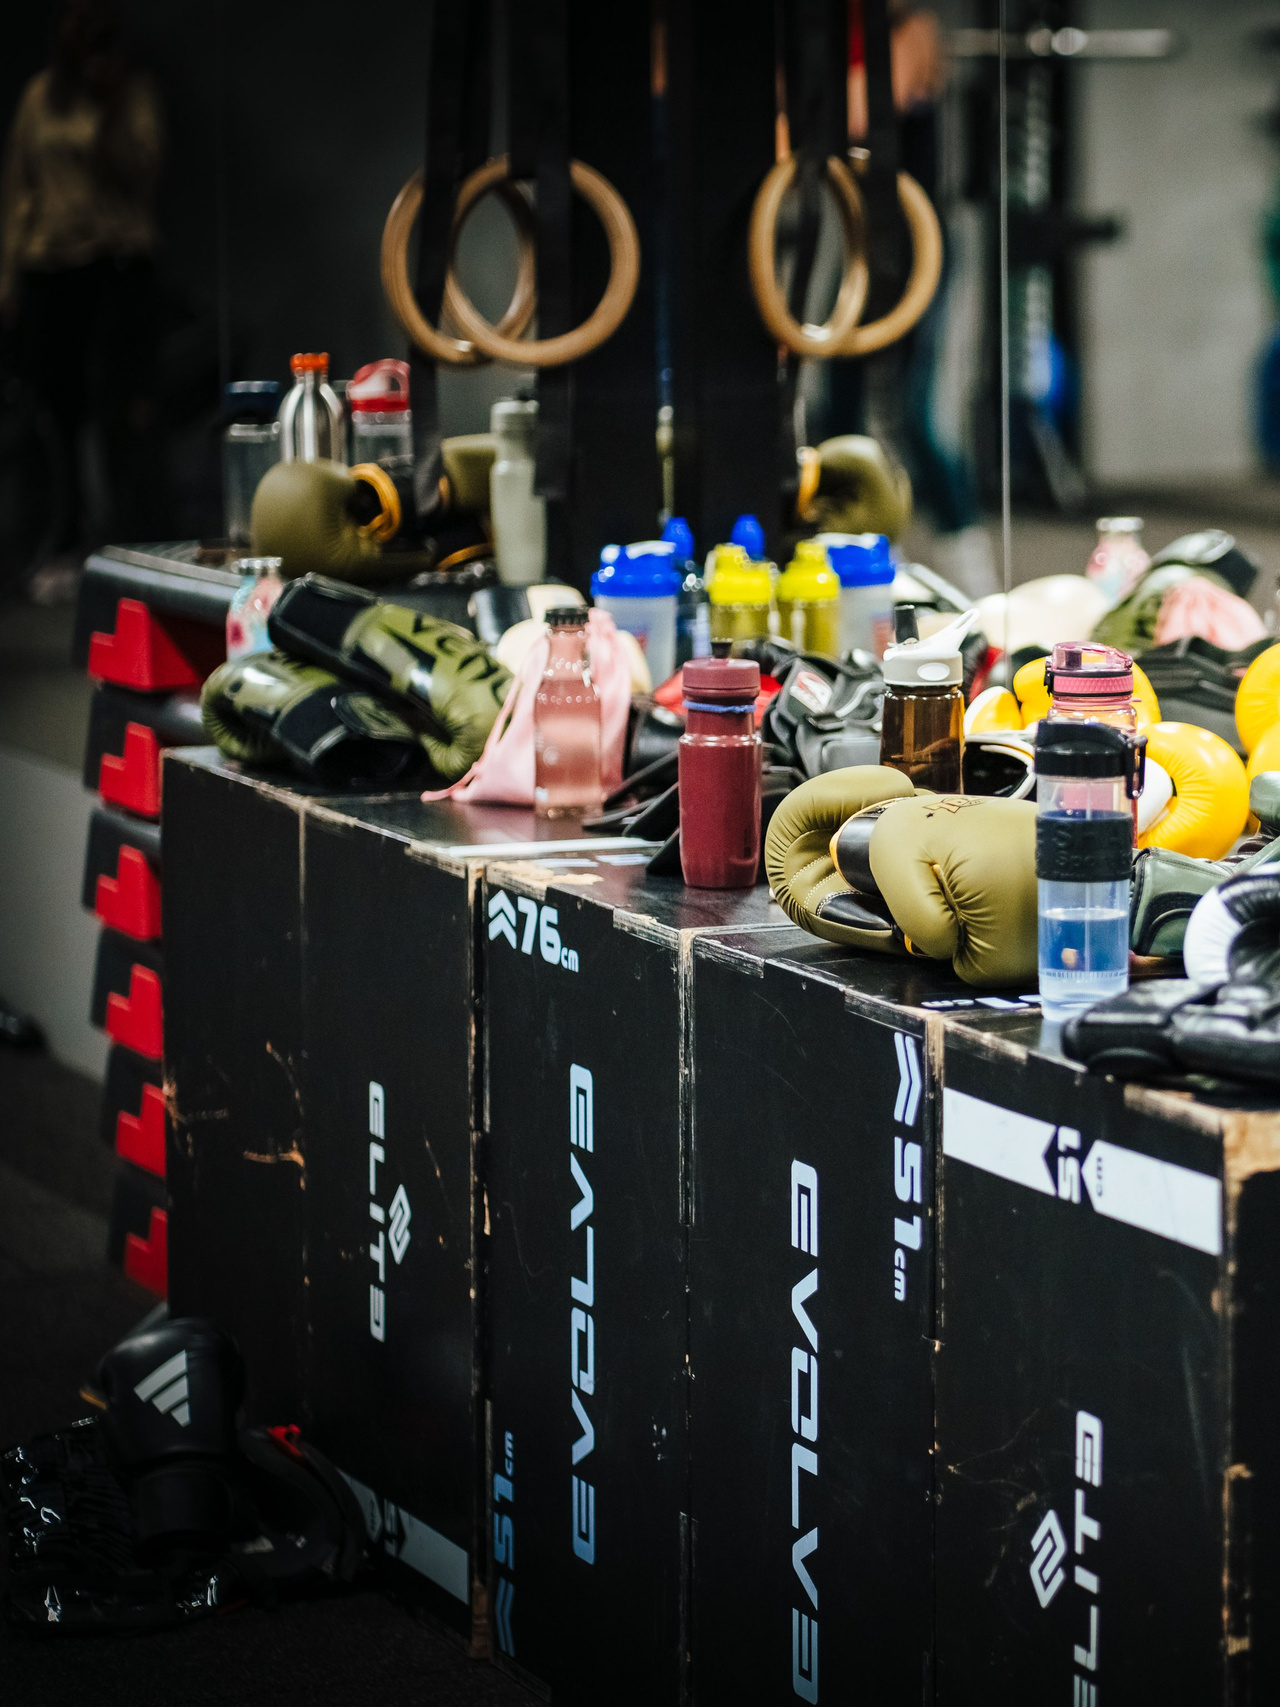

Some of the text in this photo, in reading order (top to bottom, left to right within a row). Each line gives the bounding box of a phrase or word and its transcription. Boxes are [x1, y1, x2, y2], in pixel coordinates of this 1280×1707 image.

[369, 1080, 385, 1342] ELITE
[569, 1063, 595, 1565] EVOLVE
[1057, 1125, 1081, 1204] 51
[791, 1159, 818, 1705] EVOLVE
